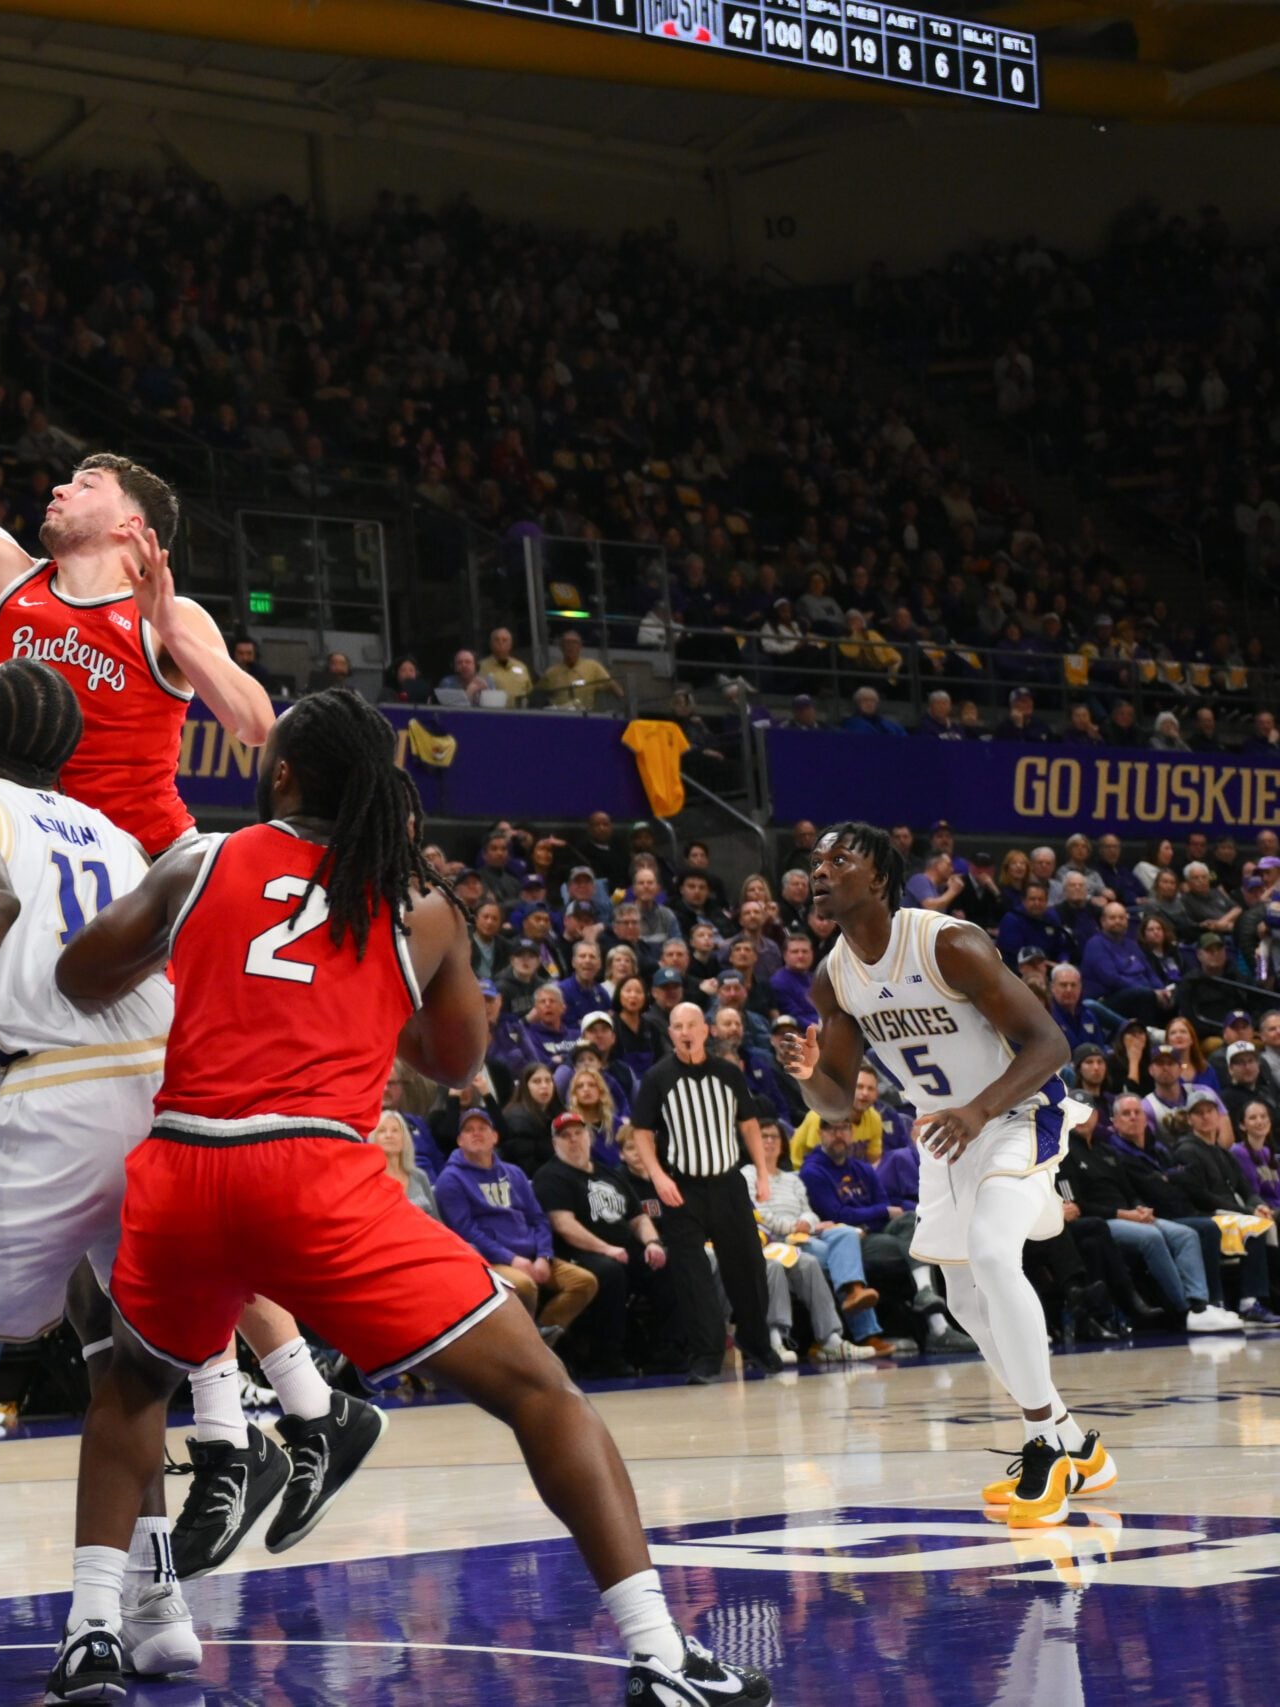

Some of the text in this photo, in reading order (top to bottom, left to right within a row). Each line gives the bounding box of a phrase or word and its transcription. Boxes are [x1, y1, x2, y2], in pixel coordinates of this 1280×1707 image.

[728, 12, 756, 40] 47
[763, 18, 802, 49] 100
[810, 28, 838, 56] 40
[851, 35, 877, 64] 19
[898, 45, 912, 71] 8
[934, 53, 949, 78] 6
[972, 60, 987, 86] 2
[1011, 68, 1025, 93] 0
[886, 13, 917, 29] AST
[929, 21, 952, 37] TO
[963, 28, 994, 45] BLK
[1002, 36, 1031, 53] STL
[764, 215, 797, 239] 10
[11, 626, 126, 692] Buckeyes
[1013, 756, 1280, 827] GO HUSKIE
[49, 848, 114, 947] 11
[243, 874, 331, 985] 2
[899, 1044, 953, 1097] 5
[478, 1180, 513, 1209] W
